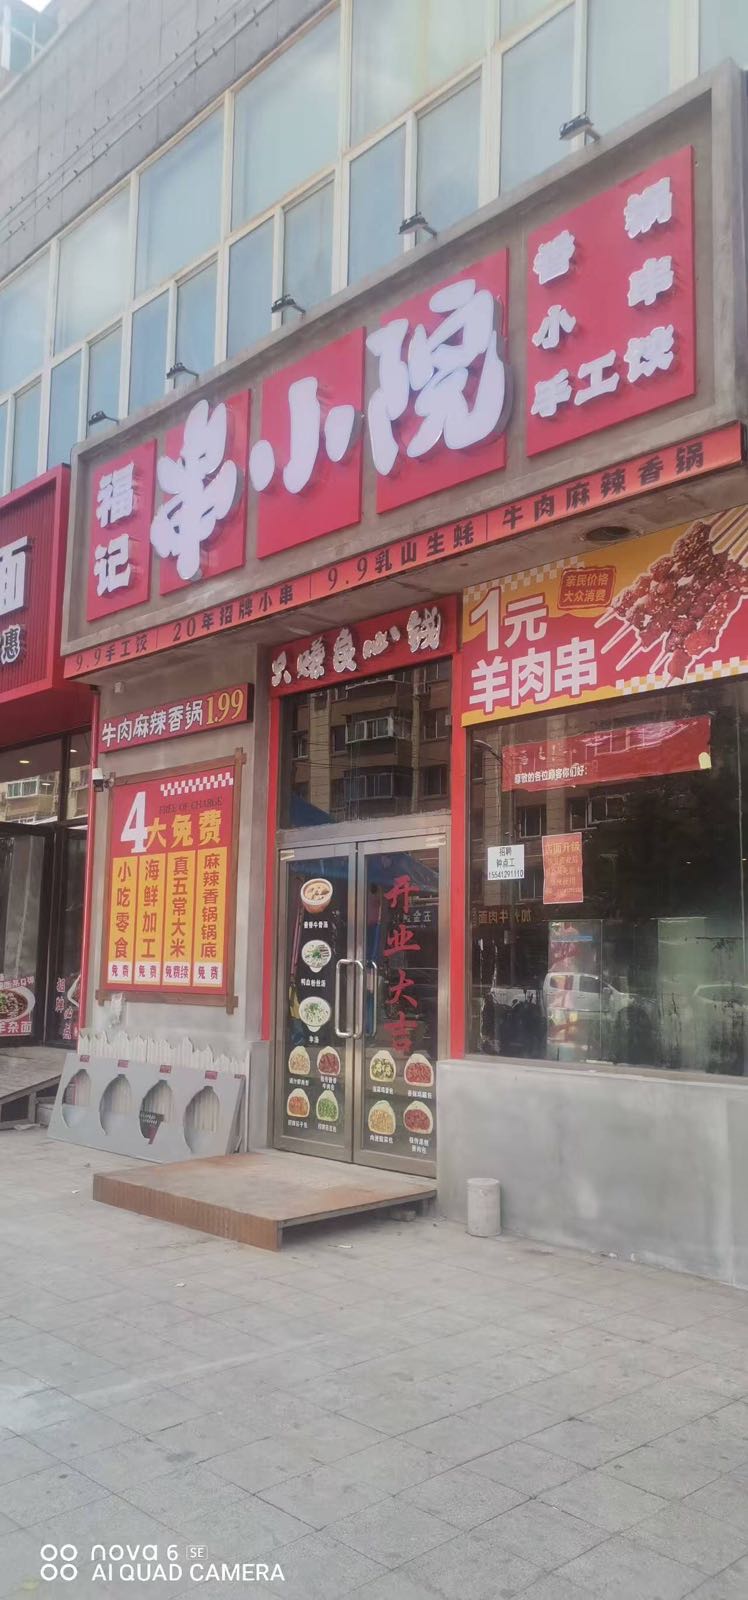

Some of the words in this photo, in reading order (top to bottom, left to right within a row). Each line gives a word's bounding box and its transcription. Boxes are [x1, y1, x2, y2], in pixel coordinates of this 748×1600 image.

[530, 324, 675, 418] 手工饺
[150, 279, 505, 580] 串小院
[75, 634, 148, 671] 9.9手工饺
[172, 584, 294, 642] 20年招牌小串
[327, 526, 475, 590] 9.9乳山生蚝
[501, 441, 704, 530] 牛肉麻辣香锅
[94, 461, 136, 597] 福记
[469, 588, 548, 652] 1元
[564, 588, 606, 602] 大众消费
[565, 572, 609, 588] 亲民价格
[468, 636, 599, 714] 羊肉串
[495, 858, 516, 868] 钟点工
[499, 846, 513, 856] 招聘
[114, 861, 132, 959] 小吃零食
[141, 859, 160, 959] 海鲜加工
[170, 856, 189, 958] 真五常大米
[200, 852, 220, 959] 麻辣香锅锅底
[111, 964, 129, 977] 免费
[138, 964, 157, 978] 免费
[198, 965, 218, 980] 免费
[383, 874, 422, 1052] 开业大吉
